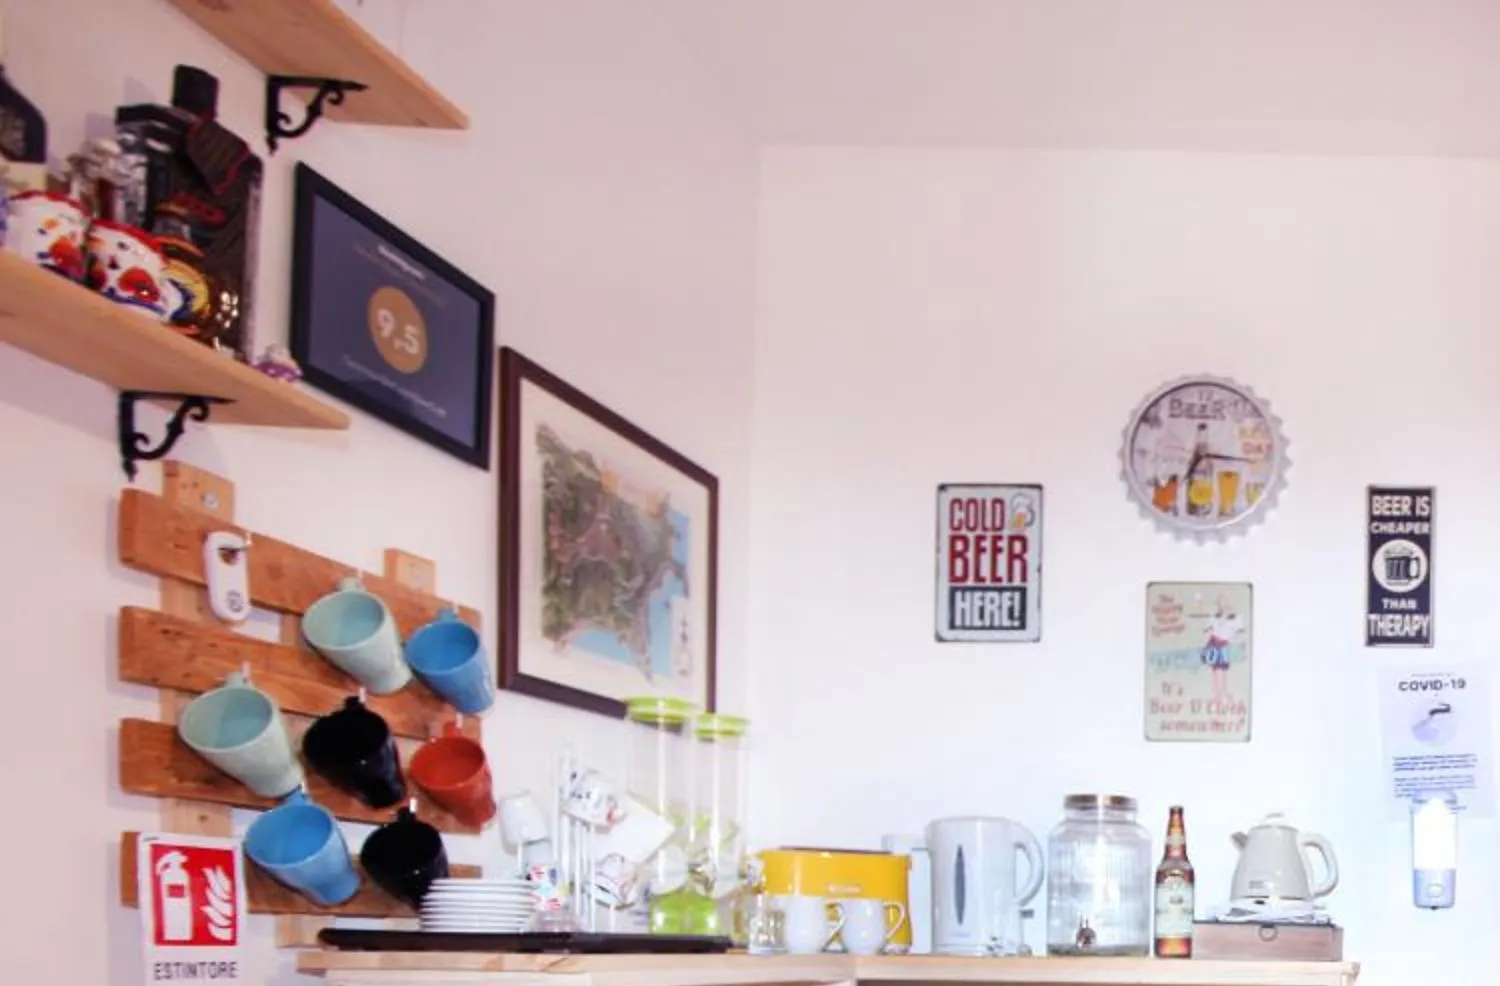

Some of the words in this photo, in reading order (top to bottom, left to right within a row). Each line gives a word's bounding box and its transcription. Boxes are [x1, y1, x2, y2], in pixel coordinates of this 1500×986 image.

[950, 498, 1005, 531] COLD
[1371, 495, 1412, 516] BEER
[1415, 495, 1430, 516] IS
[1370, 522, 1430, 534] CHEAPER
[949, 534, 1028, 583] BEER
[954, 591, 1021, 627] HERE!
[1382, 598, 1417, 609] THAN
[1368, 614, 1430, 637] THERAPY
[1398, 677, 1467, 691] COVID-19
[153, 961, 239, 981] ESTINTORE
